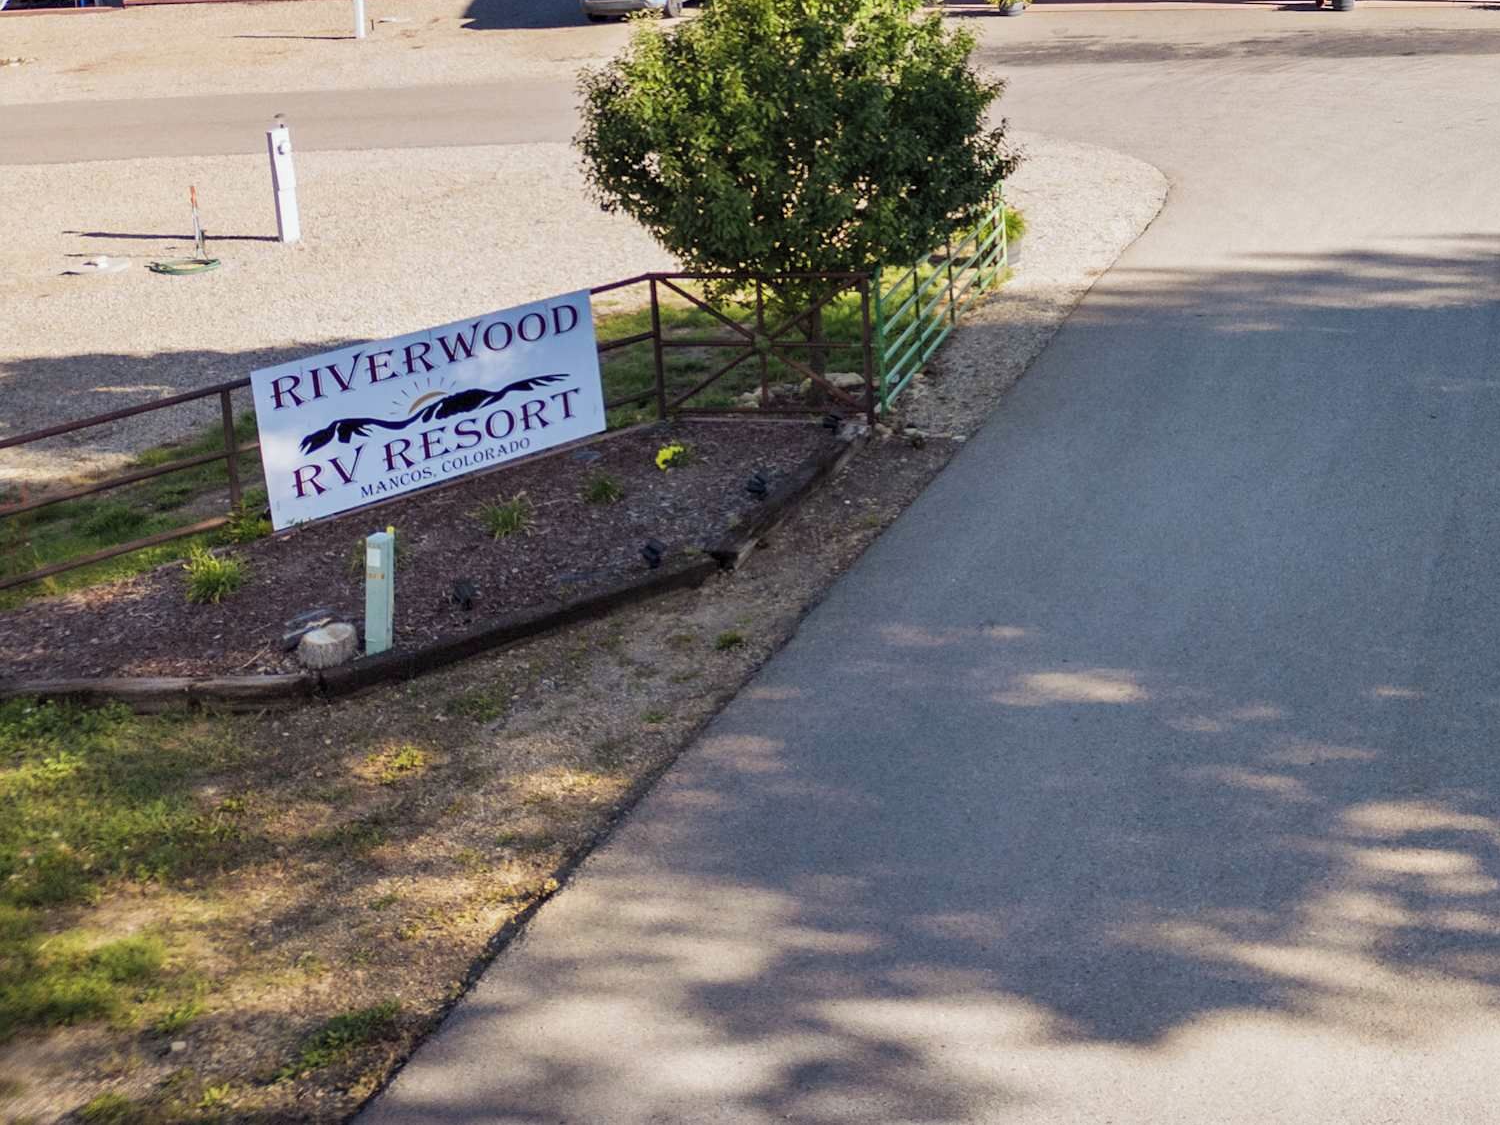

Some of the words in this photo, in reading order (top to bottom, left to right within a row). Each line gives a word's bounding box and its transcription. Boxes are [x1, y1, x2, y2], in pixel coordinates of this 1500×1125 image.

[270, 304, 579, 411] RIVERWOOD
[292, 443, 365, 499] RV
[383, 387, 581, 472] RESORT
[360, 465, 437, 499] MANCOS,
[441, 437, 531, 474] COLORADO
